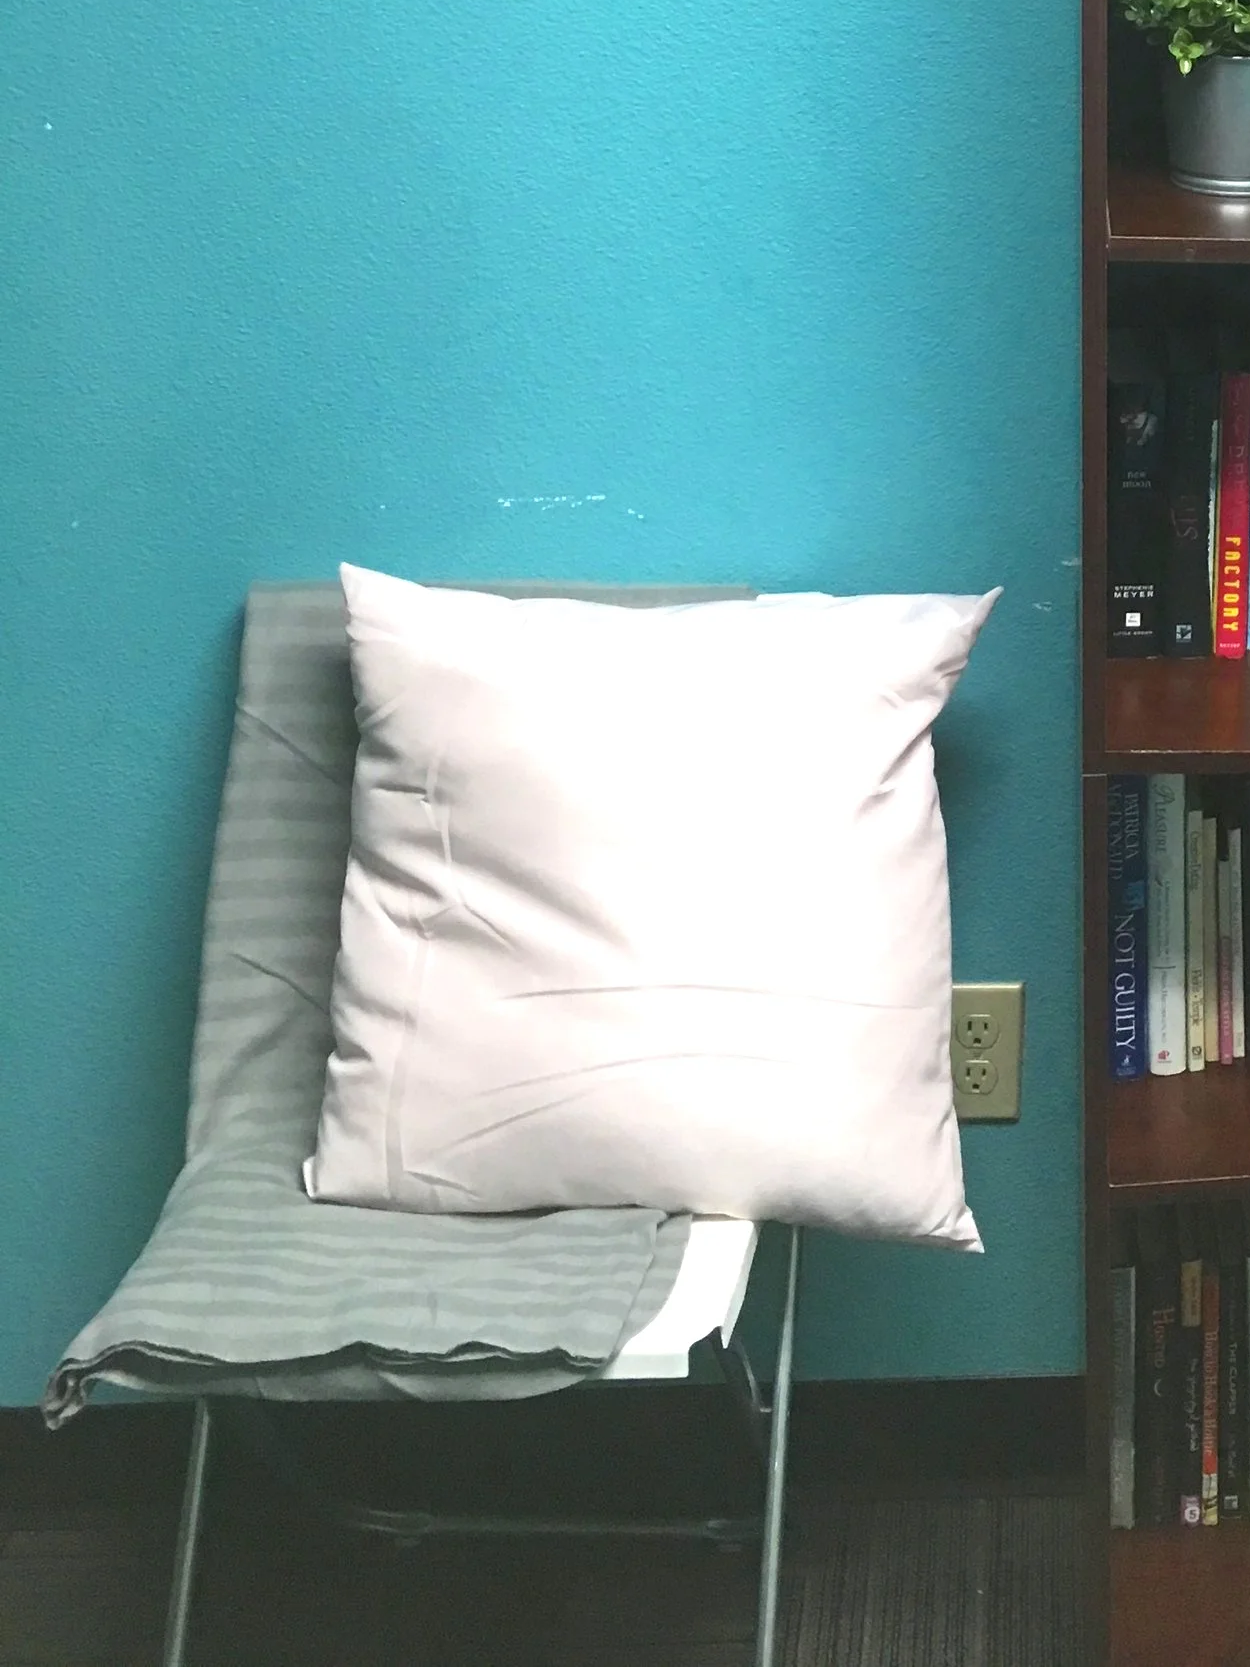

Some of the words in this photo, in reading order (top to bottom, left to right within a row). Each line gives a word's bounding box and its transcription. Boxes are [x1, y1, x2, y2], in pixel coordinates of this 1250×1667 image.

[1224, 537, 1241, 632] FACTORY
[1115, 914, 1136, 968] NOT
[1115, 973, 1136, 1049] GUILTY
